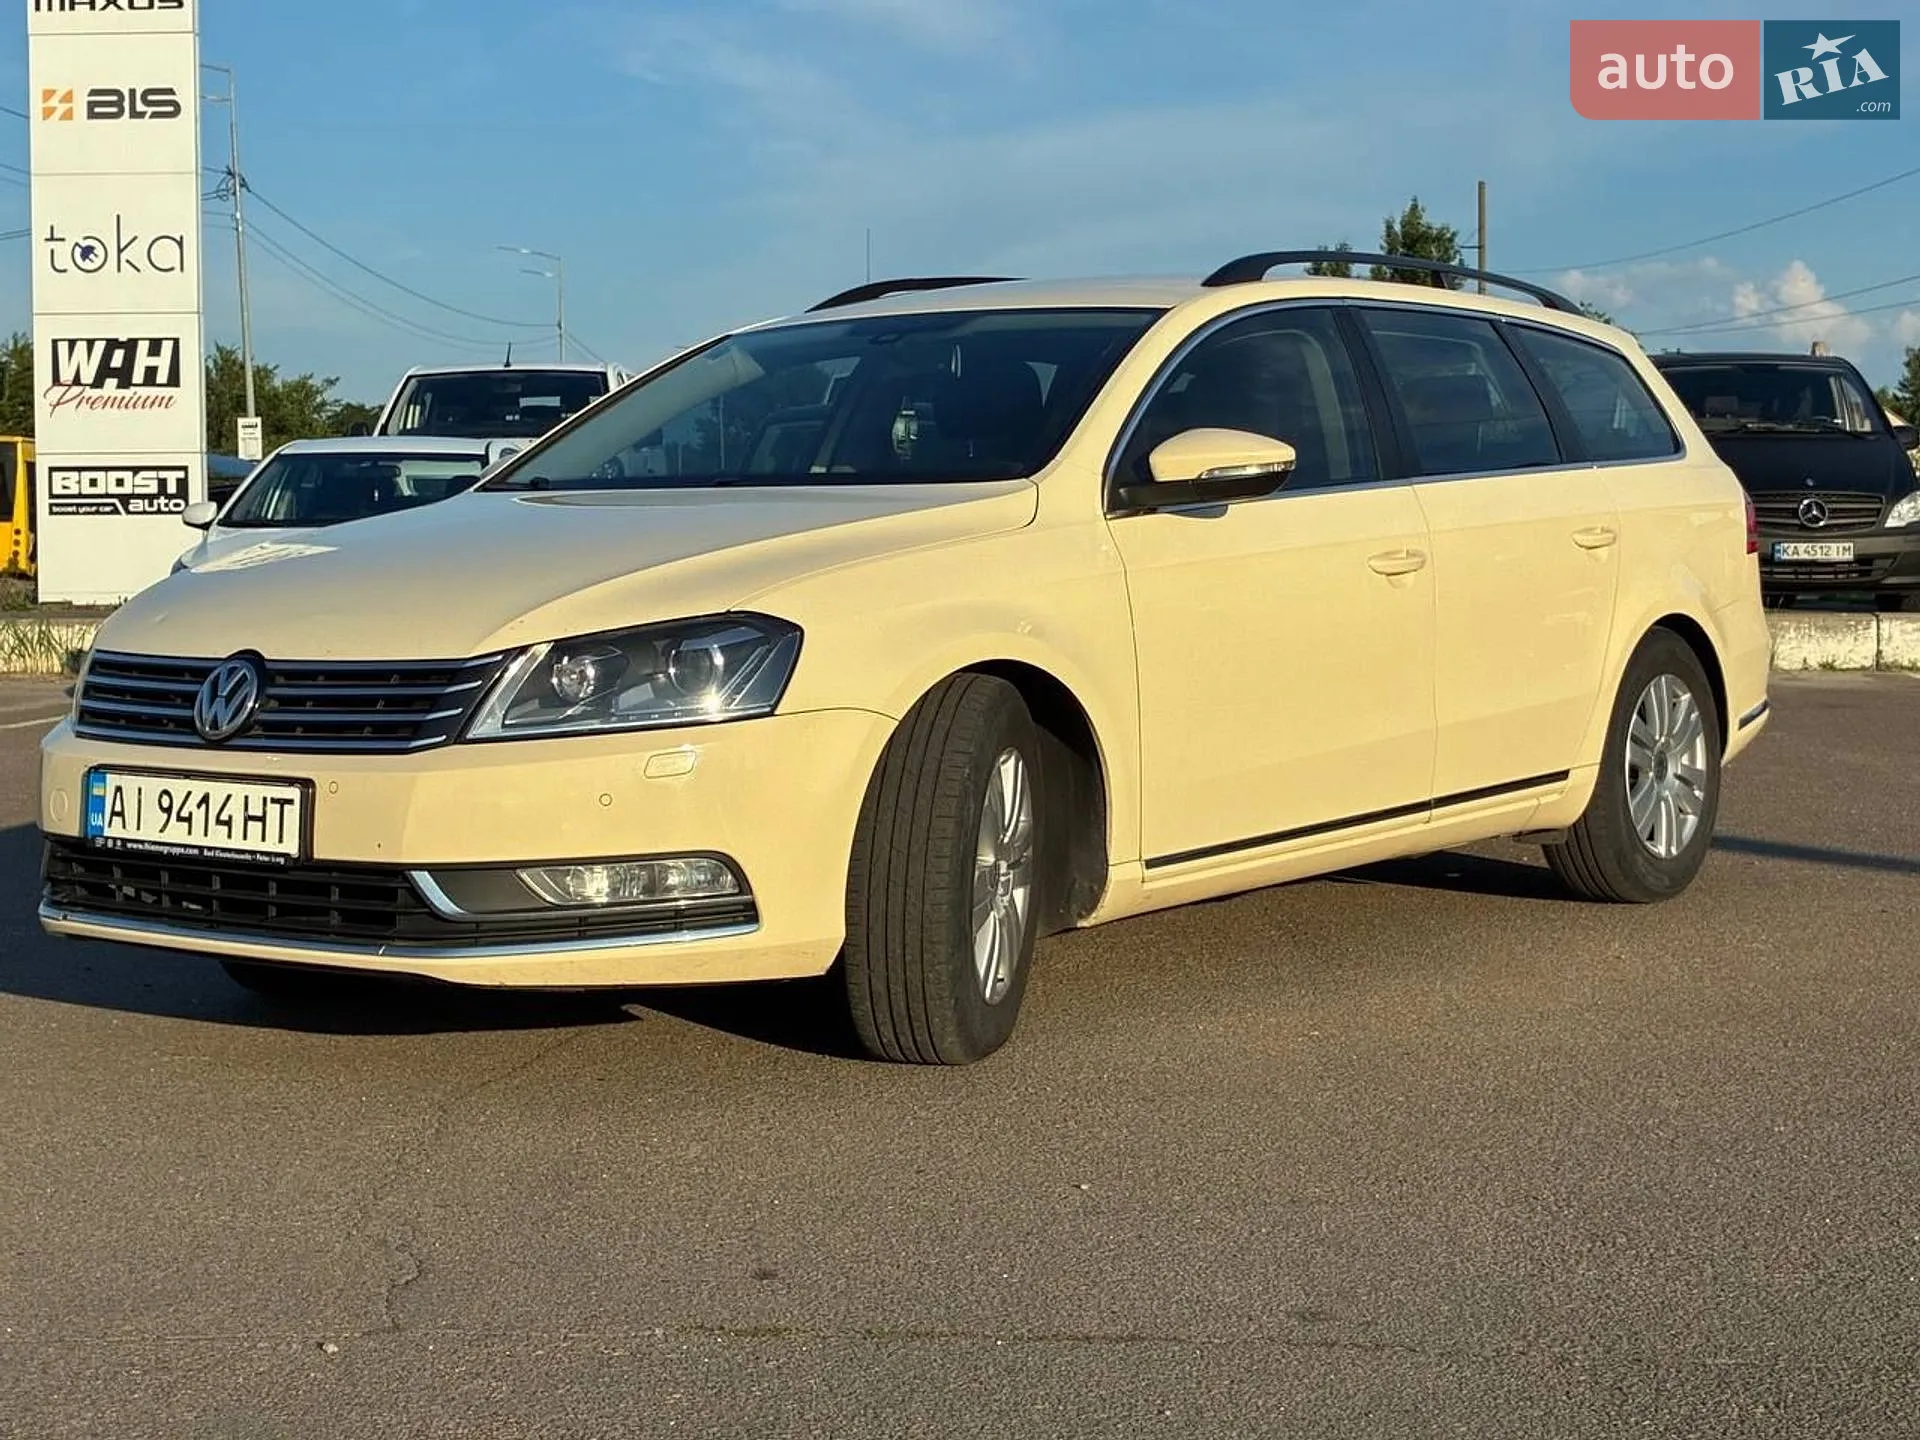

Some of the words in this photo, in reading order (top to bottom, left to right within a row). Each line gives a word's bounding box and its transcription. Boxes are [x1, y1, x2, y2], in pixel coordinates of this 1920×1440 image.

[86, 87, 182, 121] BLS
[44, 213, 184, 274] toka
[43, 379, 177, 418] Premium
[52, 471, 186, 495] BOOST
[128, 496, 186, 513] auto
[1782, 545, 1800, 557] KA
[1804, 545, 1832, 557] 4512
[91, 812, 104, 827] UA
[157, 788, 233, 840] 9414
[243, 794, 295, 844] HT
